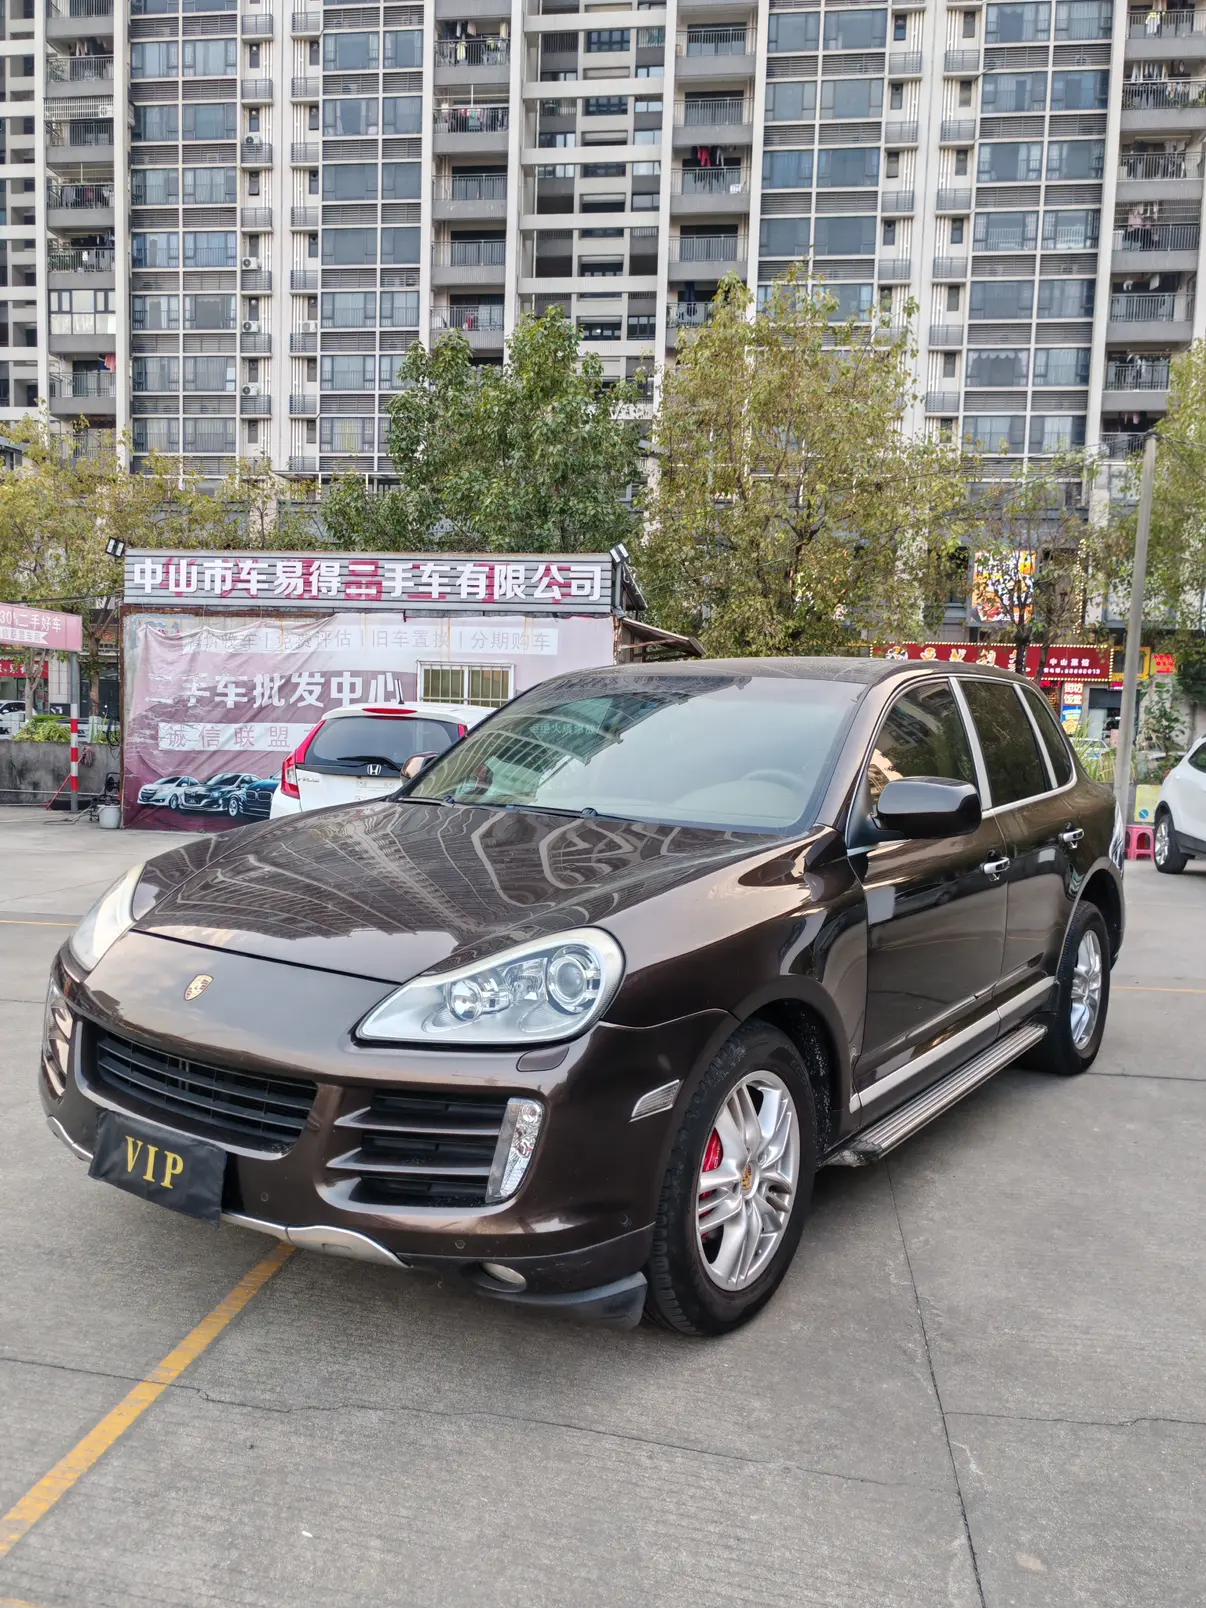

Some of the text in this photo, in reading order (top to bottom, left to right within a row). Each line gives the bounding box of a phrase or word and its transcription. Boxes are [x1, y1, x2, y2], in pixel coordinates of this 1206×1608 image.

[134, 558, 602, 601] 中山市车易得二手车有限公司
[372, 630, 450, 649] 旧车置换
[471, 631, 552, 651] 分期购车
[145, 671, 405, 709] 二手车批发中心
[166, 725, 316, 748] 诚信联盟
[125, 1136, 184, 1189] VIP
